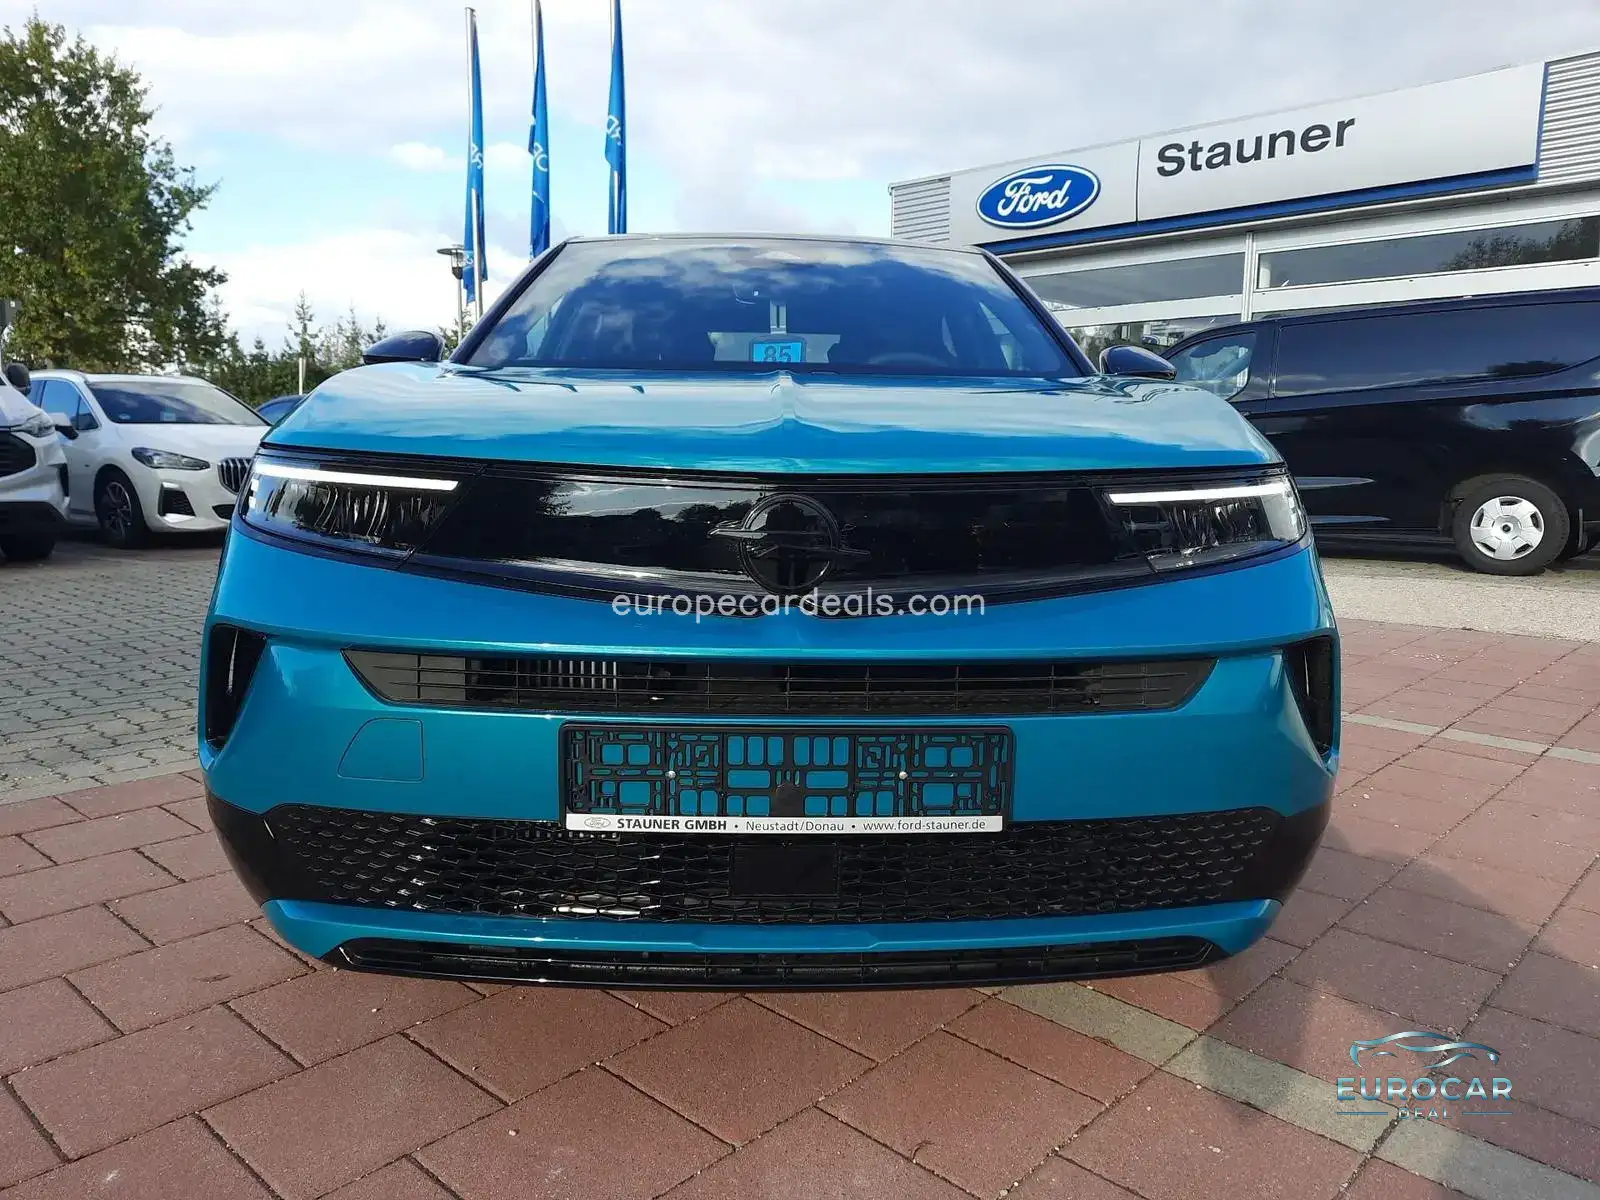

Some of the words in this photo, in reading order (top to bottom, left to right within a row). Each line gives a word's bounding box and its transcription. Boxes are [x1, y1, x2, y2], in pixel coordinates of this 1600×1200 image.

[1157, 117, 1356, 178] Stauner
[997, 174, 1070, 217] Ford
[617, 818, 680, 831] STAUNER
[684, 819, 727, 831] GMBH
[746, 820, 845, 831] Neustadt/Donau
[862, 819, 986, 832] www.ford-stauner.de
